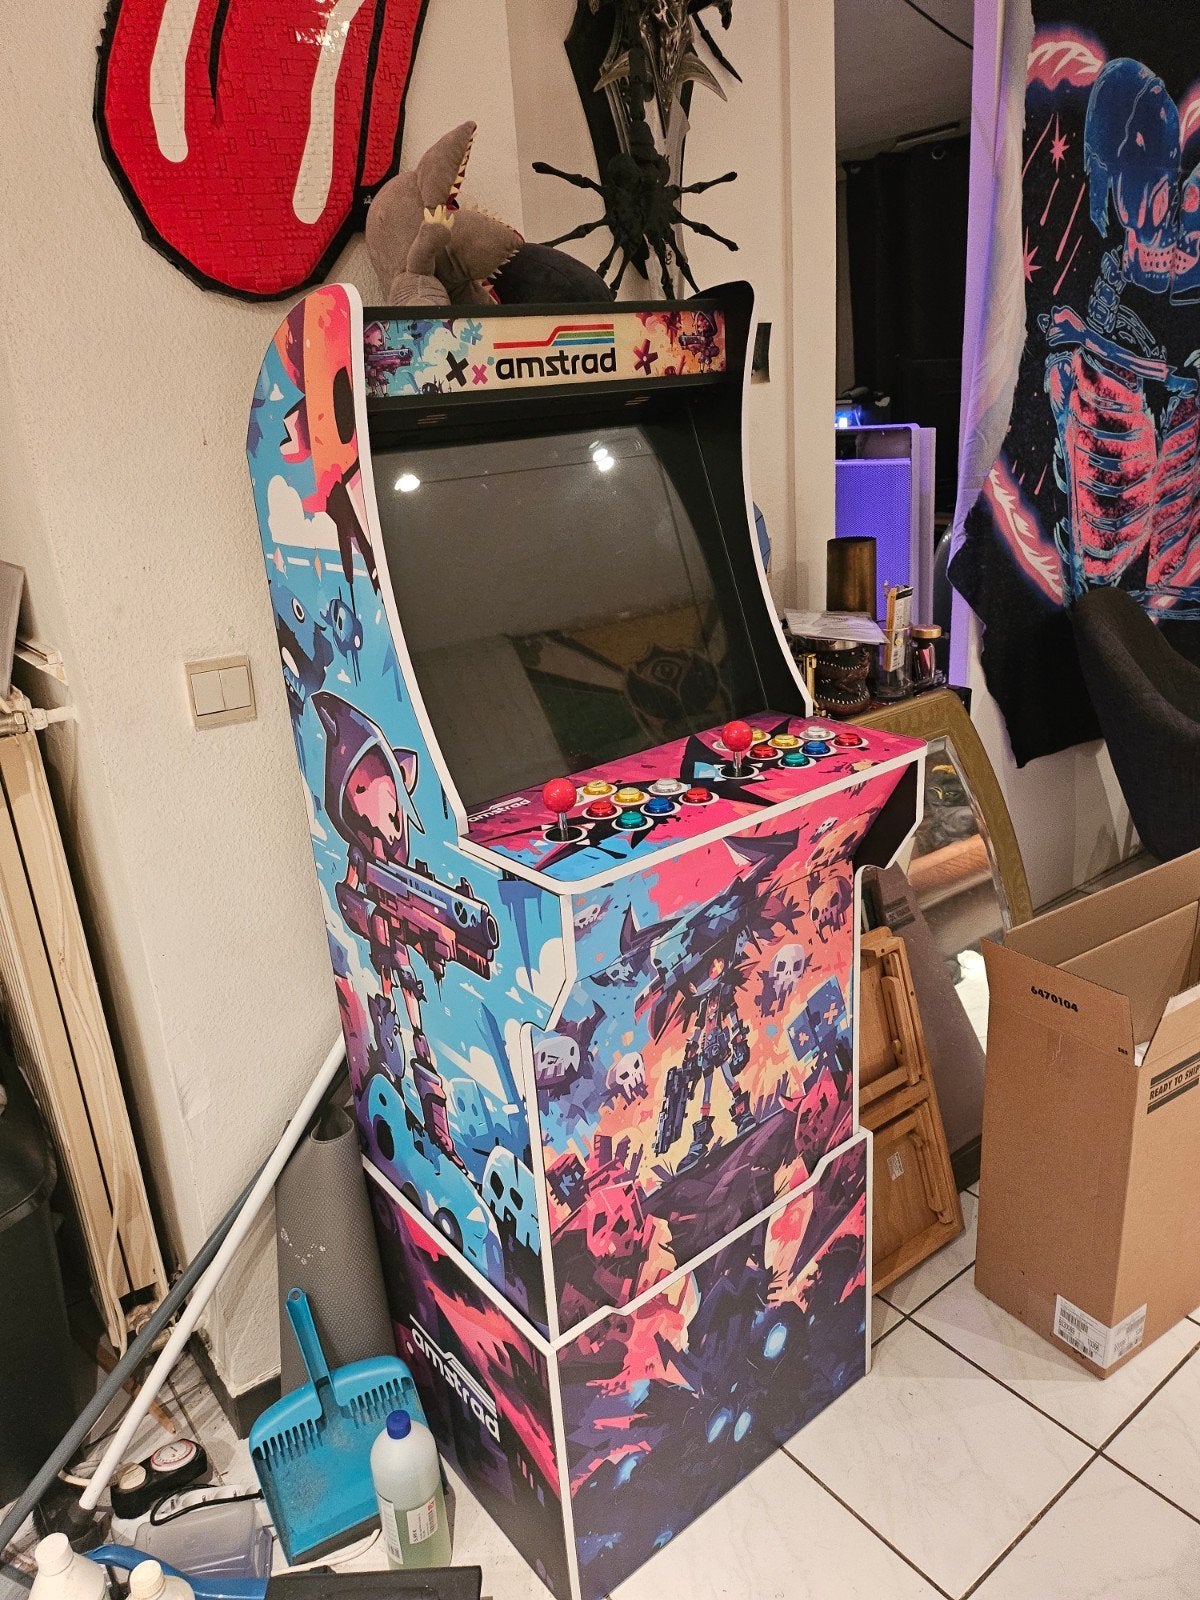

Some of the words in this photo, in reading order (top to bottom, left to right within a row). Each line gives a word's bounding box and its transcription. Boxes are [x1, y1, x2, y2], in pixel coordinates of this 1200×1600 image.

[495, 347, 617, 380] amstrad
[467, 798, 532, 822] amstrad
[1030, 985, 1079, 1013] 6470104
[1149, 1080, 1173, 1101] READY
[1174, 1074, 1183, 1086] TO
[411, 1327, 501, 1443] amstrad
